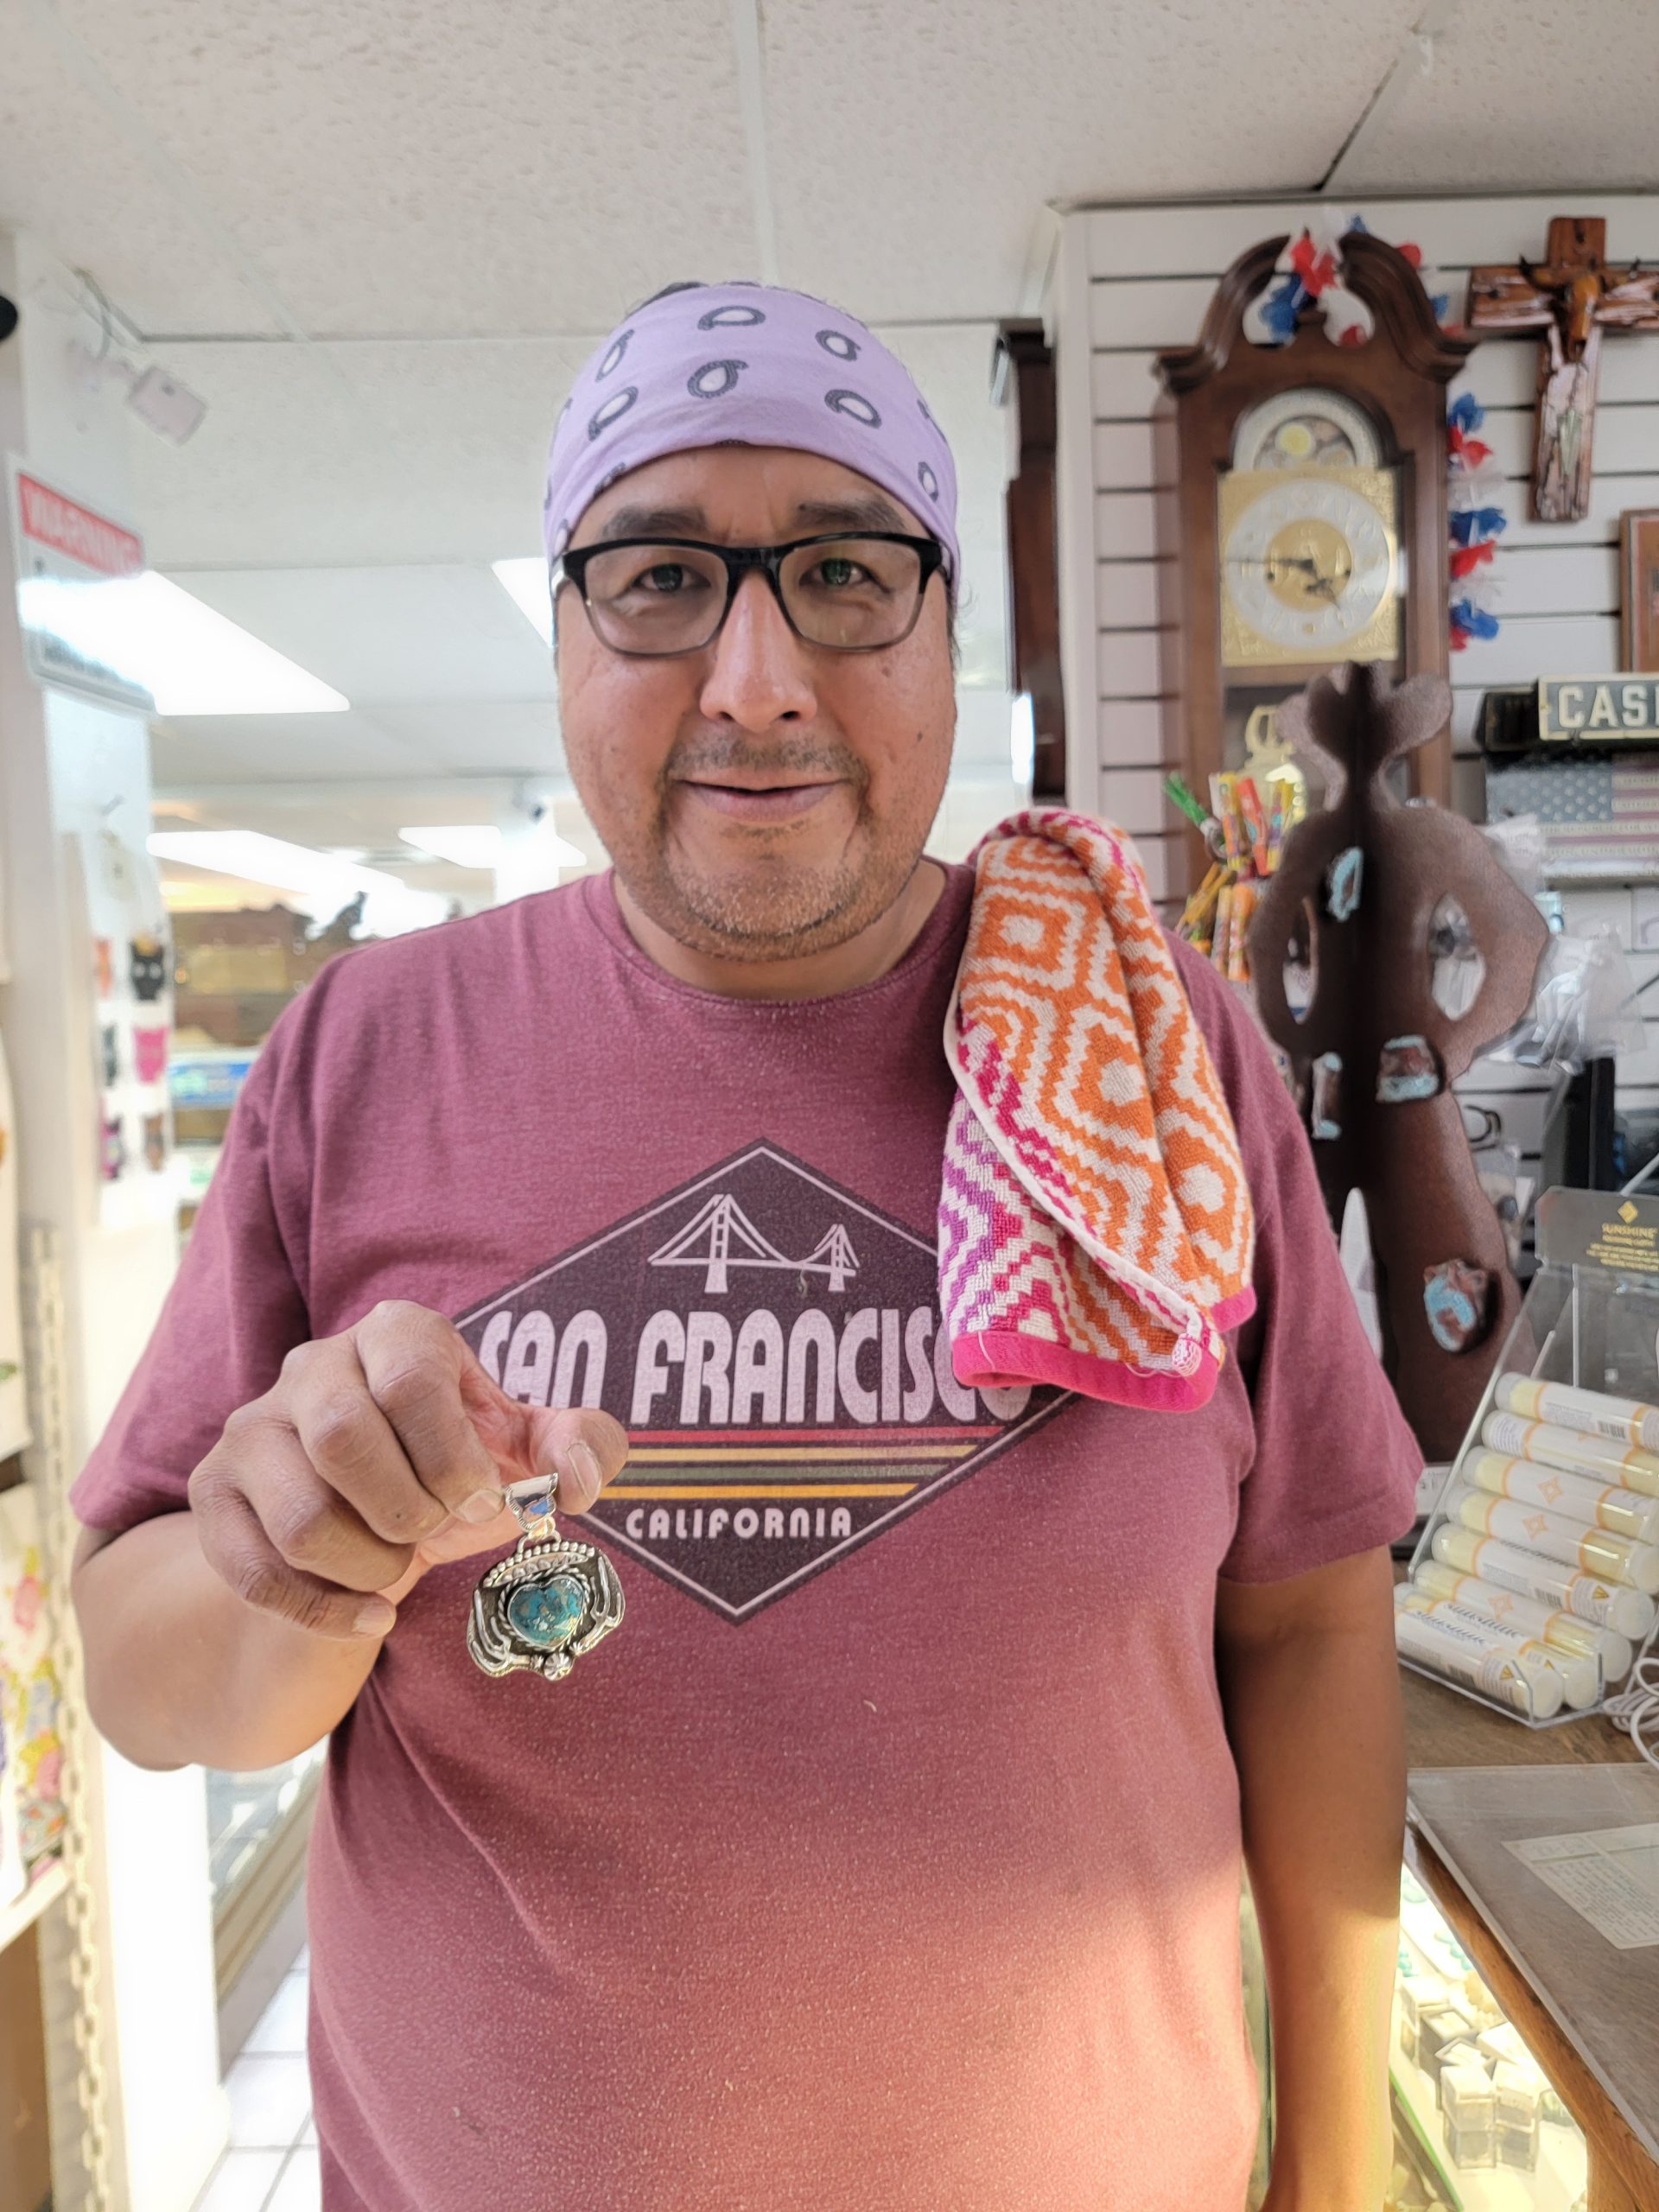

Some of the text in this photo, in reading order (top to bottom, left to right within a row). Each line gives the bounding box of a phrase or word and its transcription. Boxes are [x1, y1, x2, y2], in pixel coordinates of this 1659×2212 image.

[1558, 685, 1659, 728] CAS
[630, 1306, 1032, 1425] FRANCISC
[626, 1507, 852, 1540] CALIFORNIA
